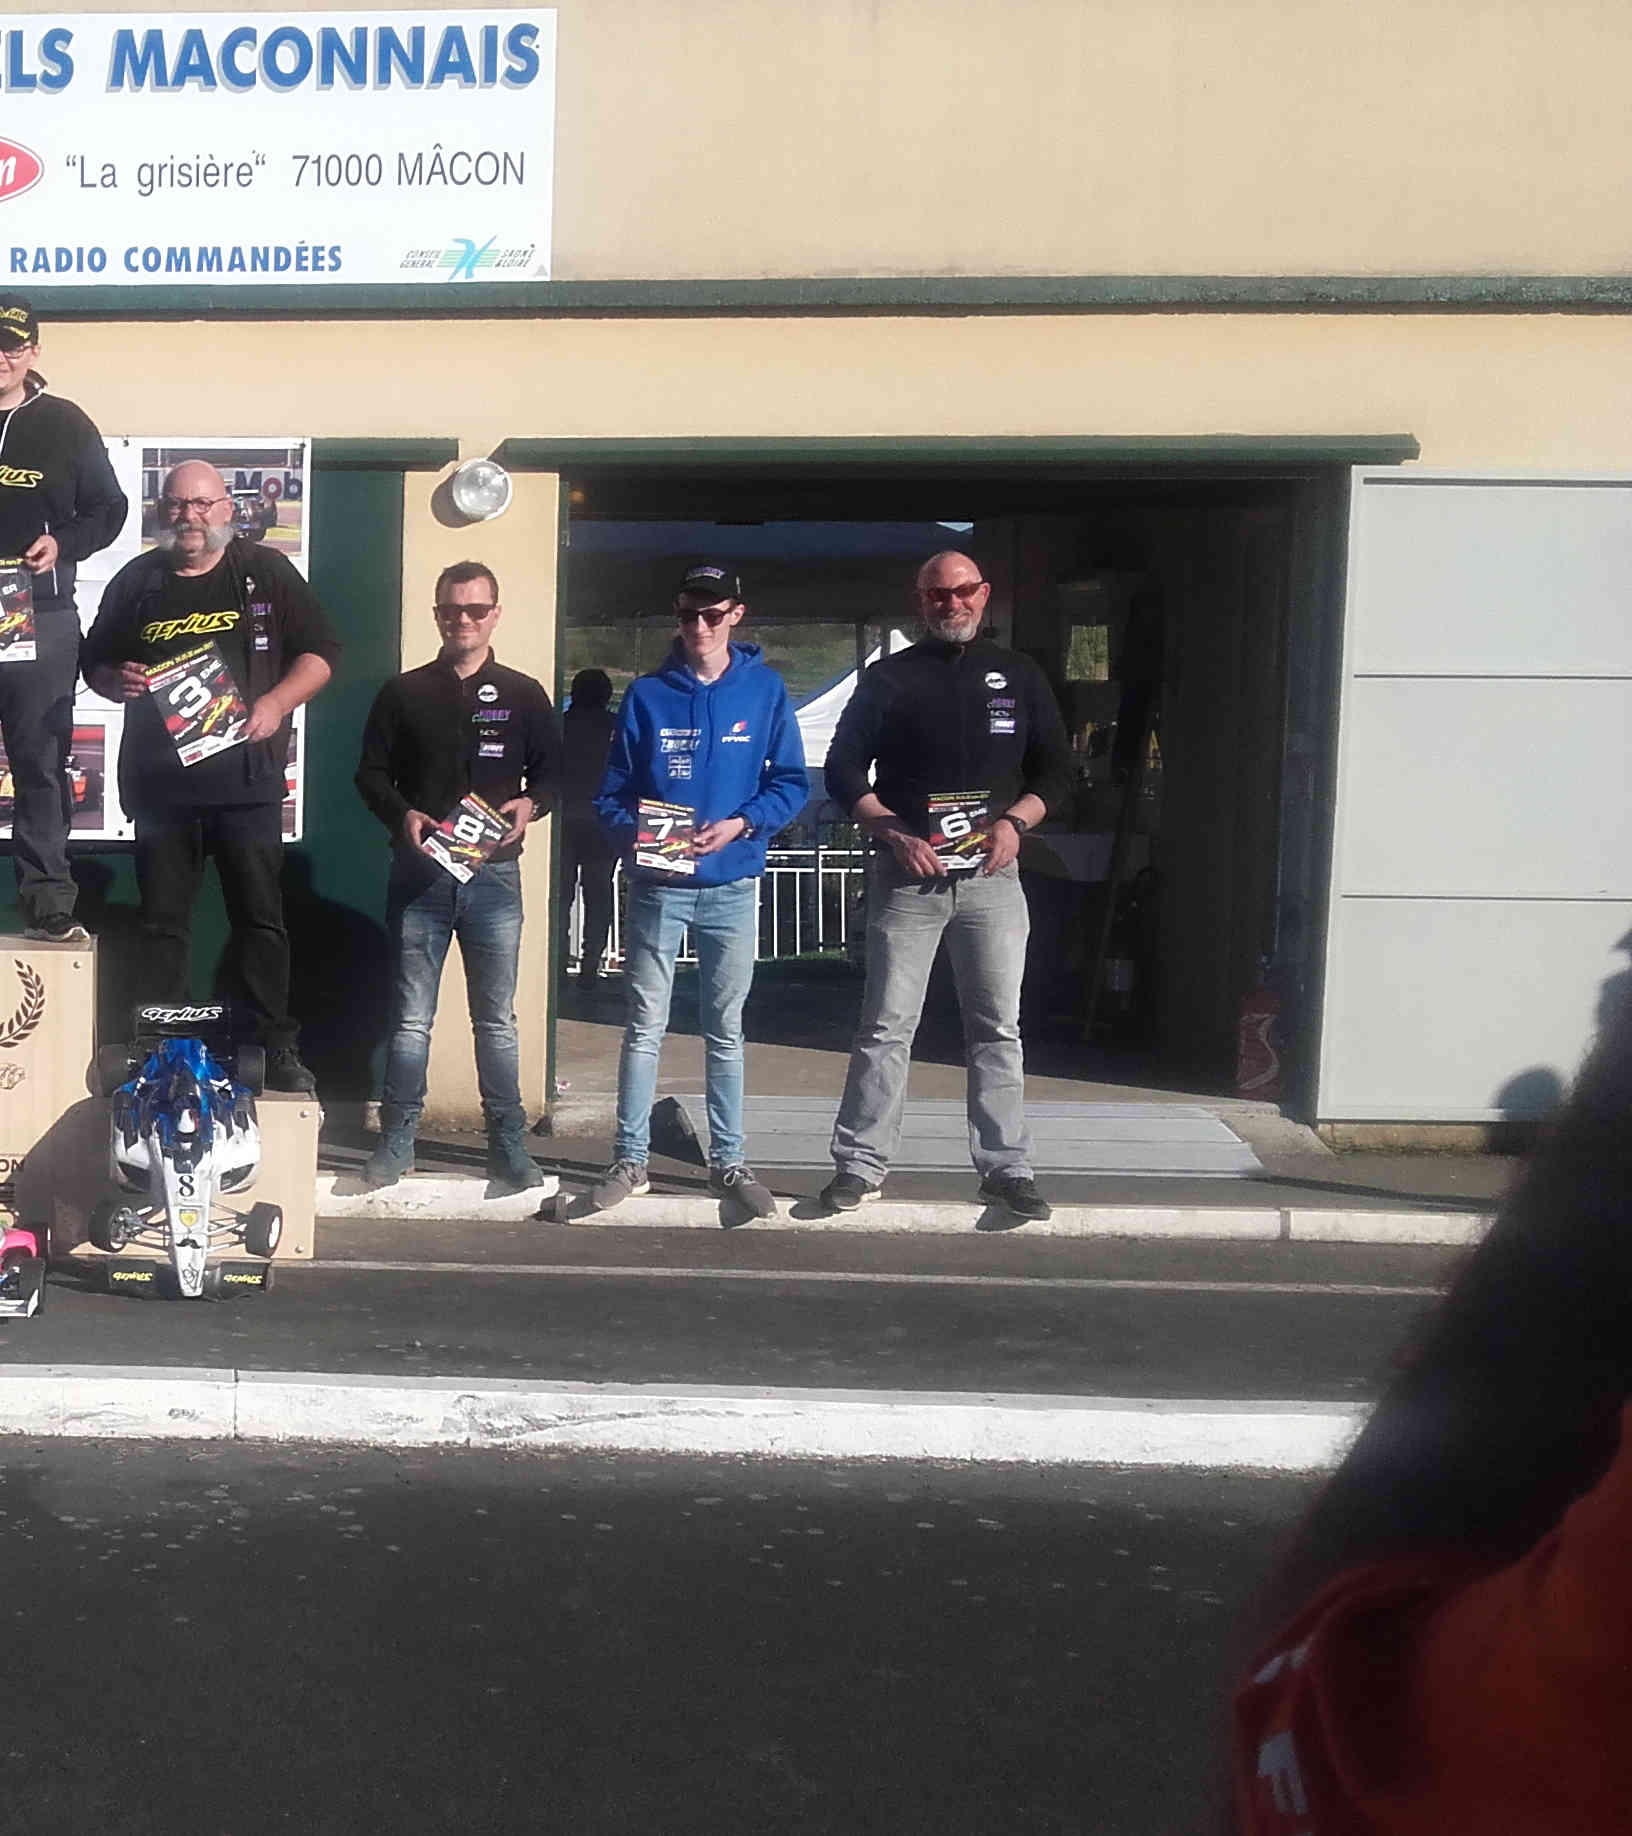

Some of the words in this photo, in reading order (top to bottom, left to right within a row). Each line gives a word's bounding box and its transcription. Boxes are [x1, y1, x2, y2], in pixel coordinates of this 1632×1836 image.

[106, 23, 540, 94] MACONNAIS
[291, 153, 383, 187] 71000
[397, 143, 525, 187] MÂCON
[10, 246, 107, 273] RADIO
[124, 241, 342, 273] COMMANDÉES
[169, 675, 212, 719] 3
[453, 814, 485, 844] 8
[647, 816, 674, 841] 7
[940, 812, 972, 839] 6
[179, 1175, 195, 1197] 8
